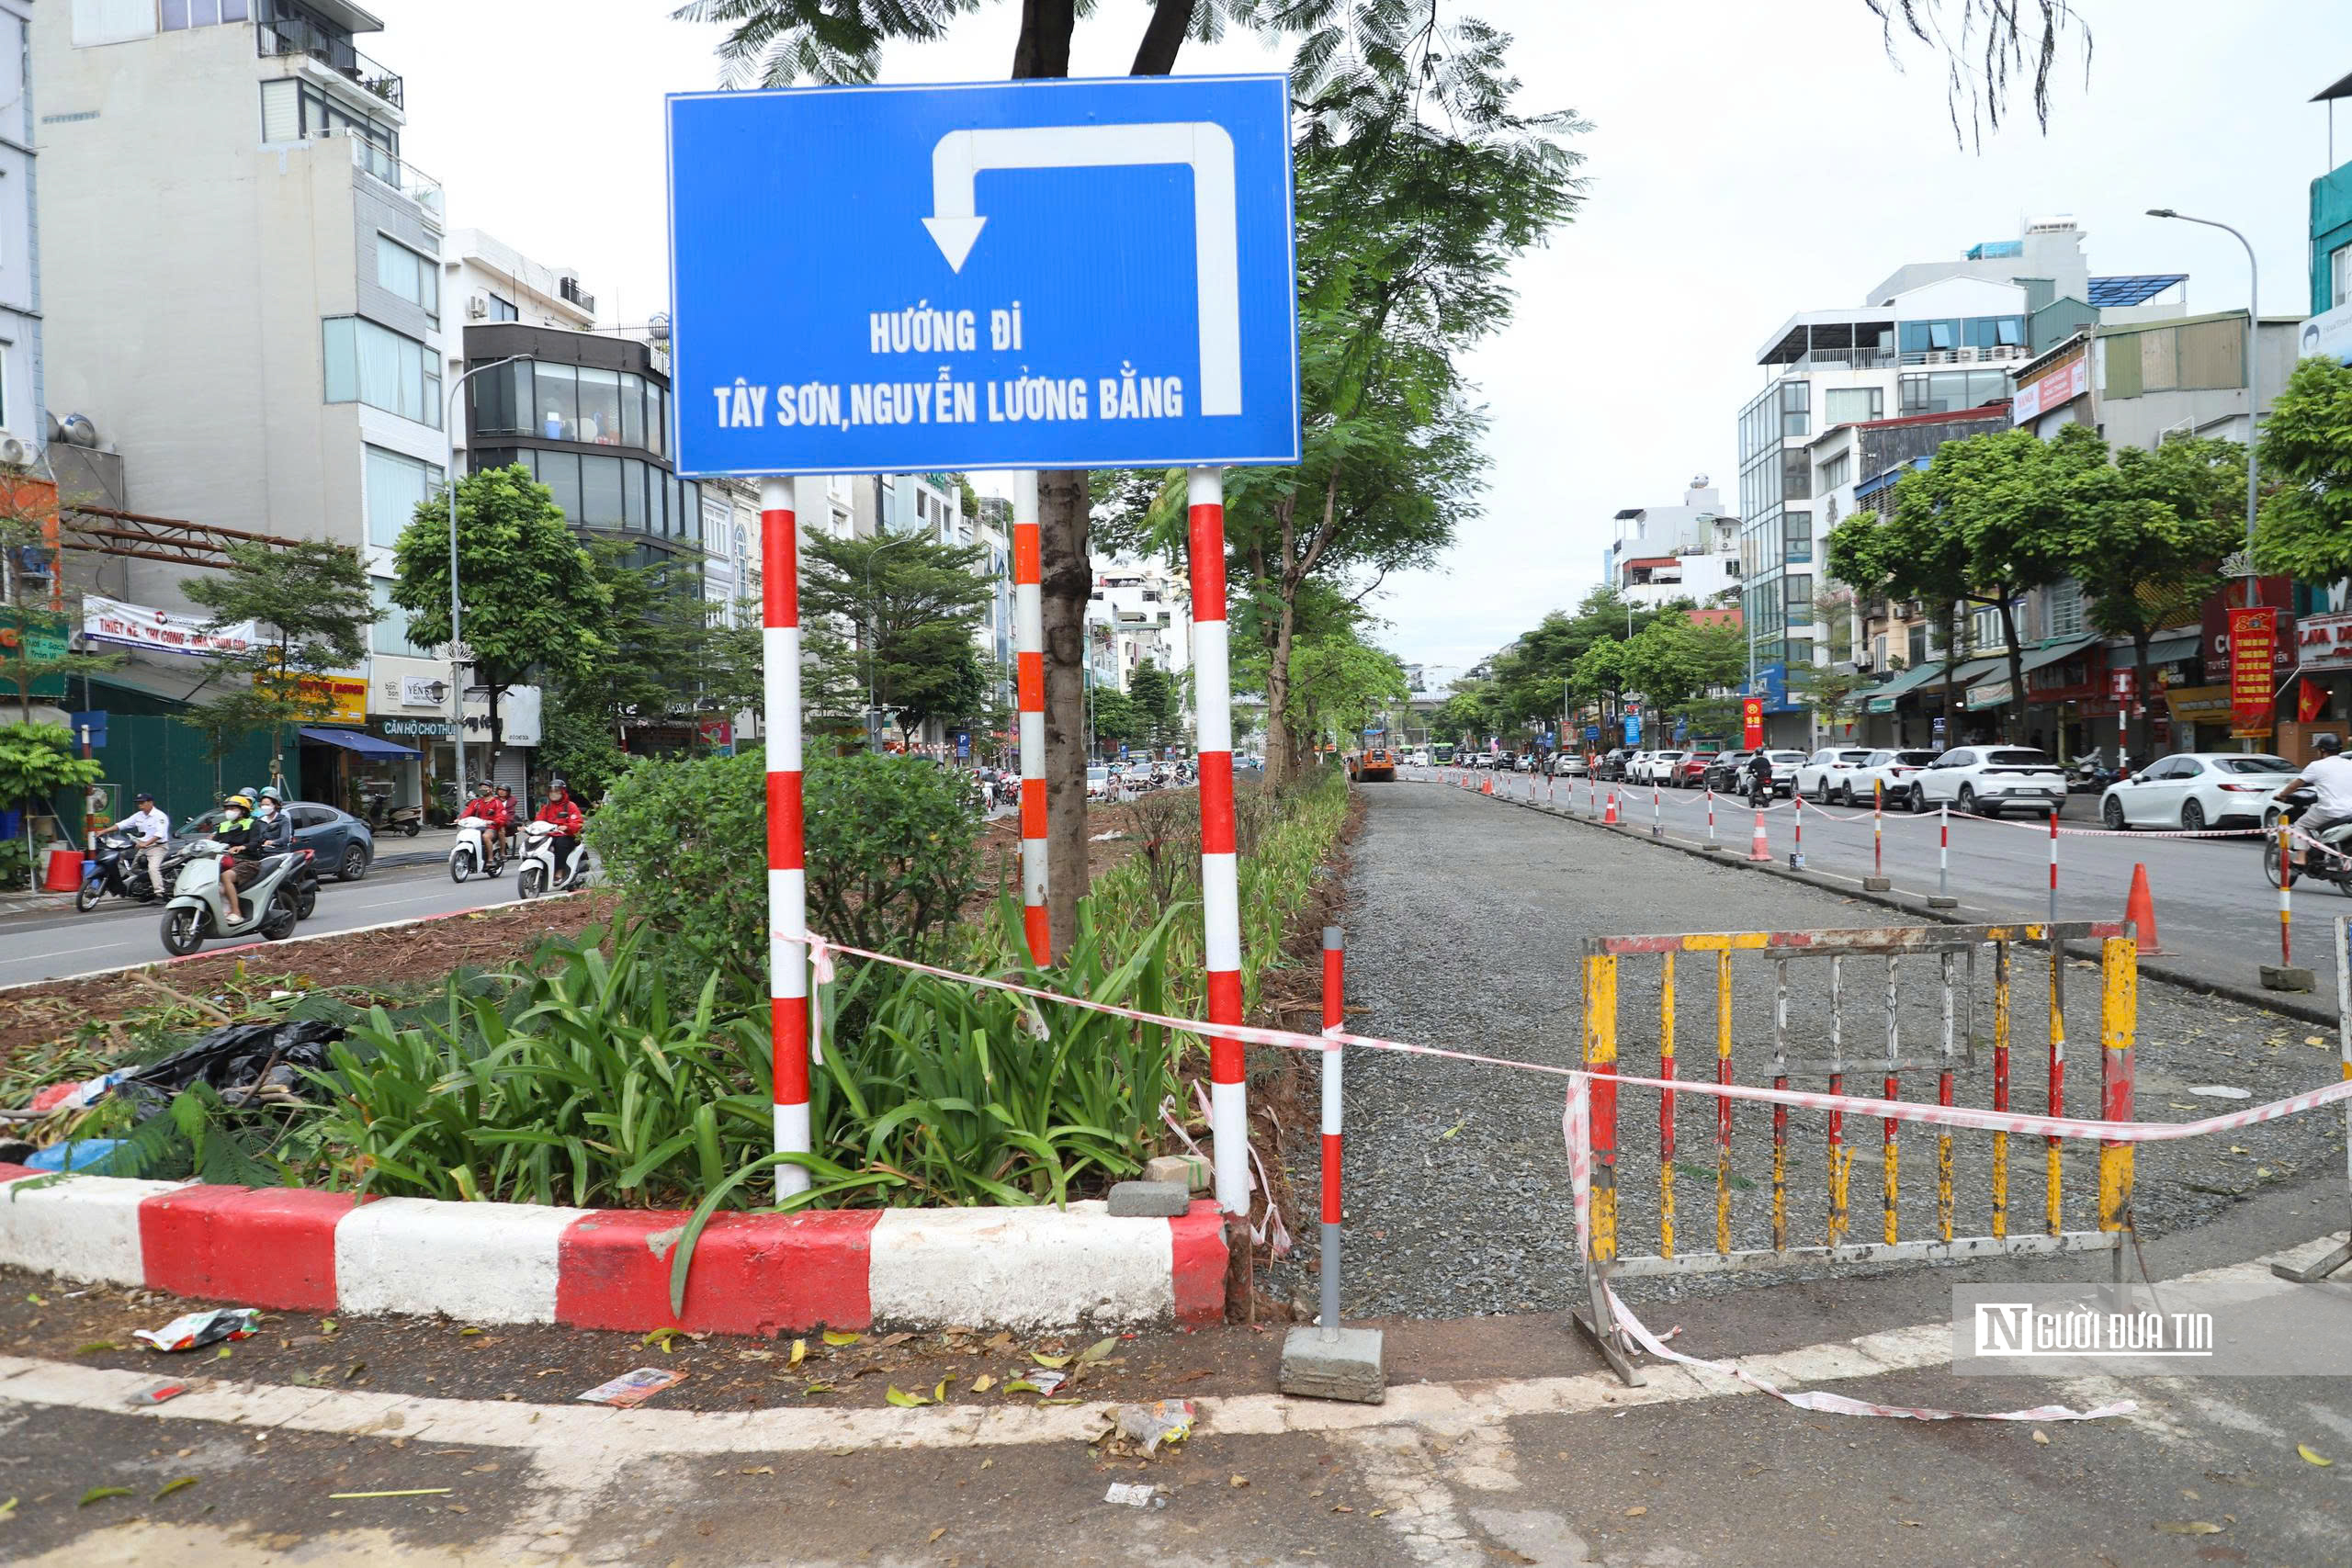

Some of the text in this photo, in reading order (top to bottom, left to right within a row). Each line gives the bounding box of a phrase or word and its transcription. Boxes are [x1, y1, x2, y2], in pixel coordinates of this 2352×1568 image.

[869, 299, 976, 354] HƯỚNG
[713, 378, 766, 428] TÂY
[1099, 360, 1183, 421] BẰNG
[384, 718, 403, 735] CĂN
[418, 724, 436, 735] CHO
[960, 735, 967, 743] P
